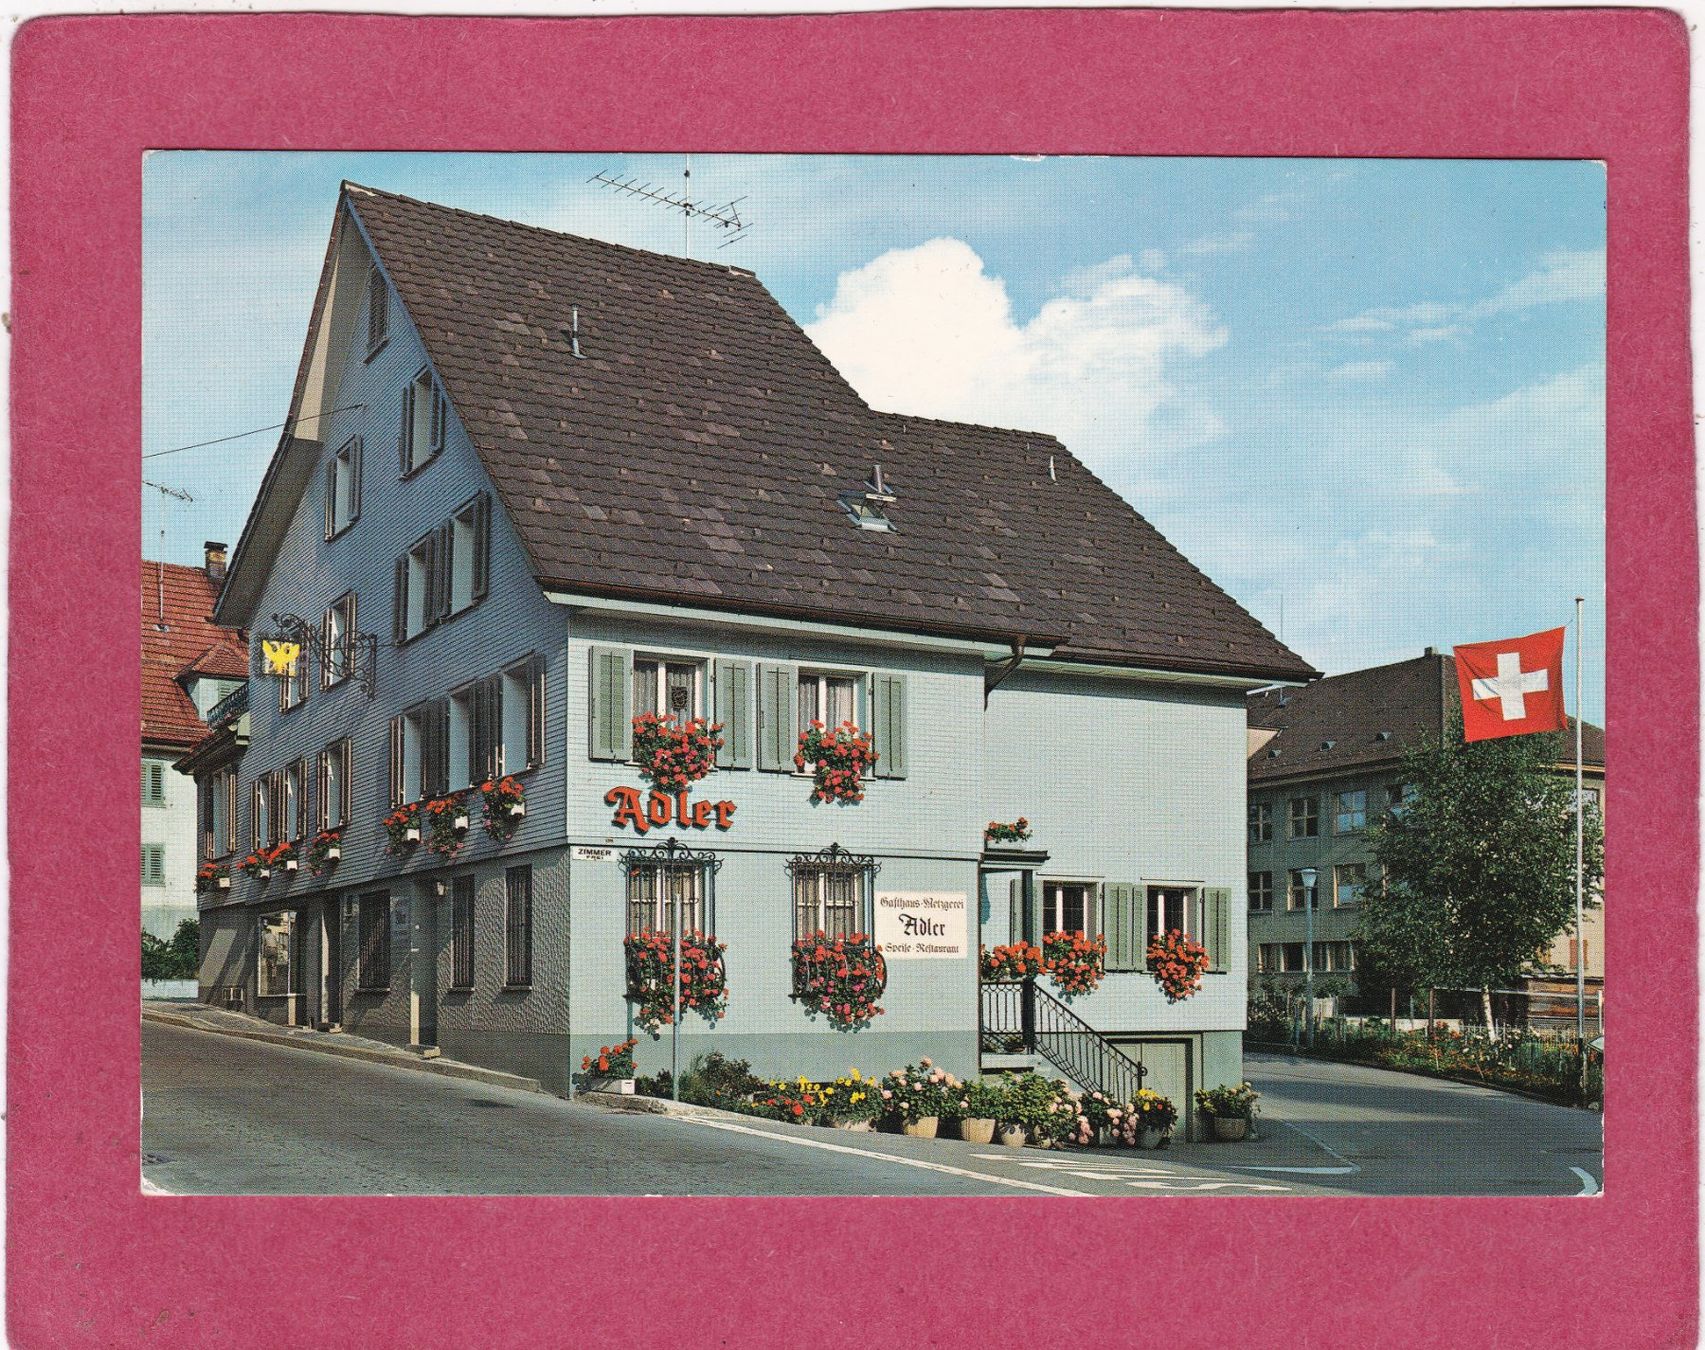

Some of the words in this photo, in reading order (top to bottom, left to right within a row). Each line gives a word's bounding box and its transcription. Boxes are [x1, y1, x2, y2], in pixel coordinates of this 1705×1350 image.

[604, 786, 738, 835] Adler
[578, 848, 612, 857] ZIMMER
[899, 913, 946, 936] Adler
[968, 1153, 1293, 1191] STOP
